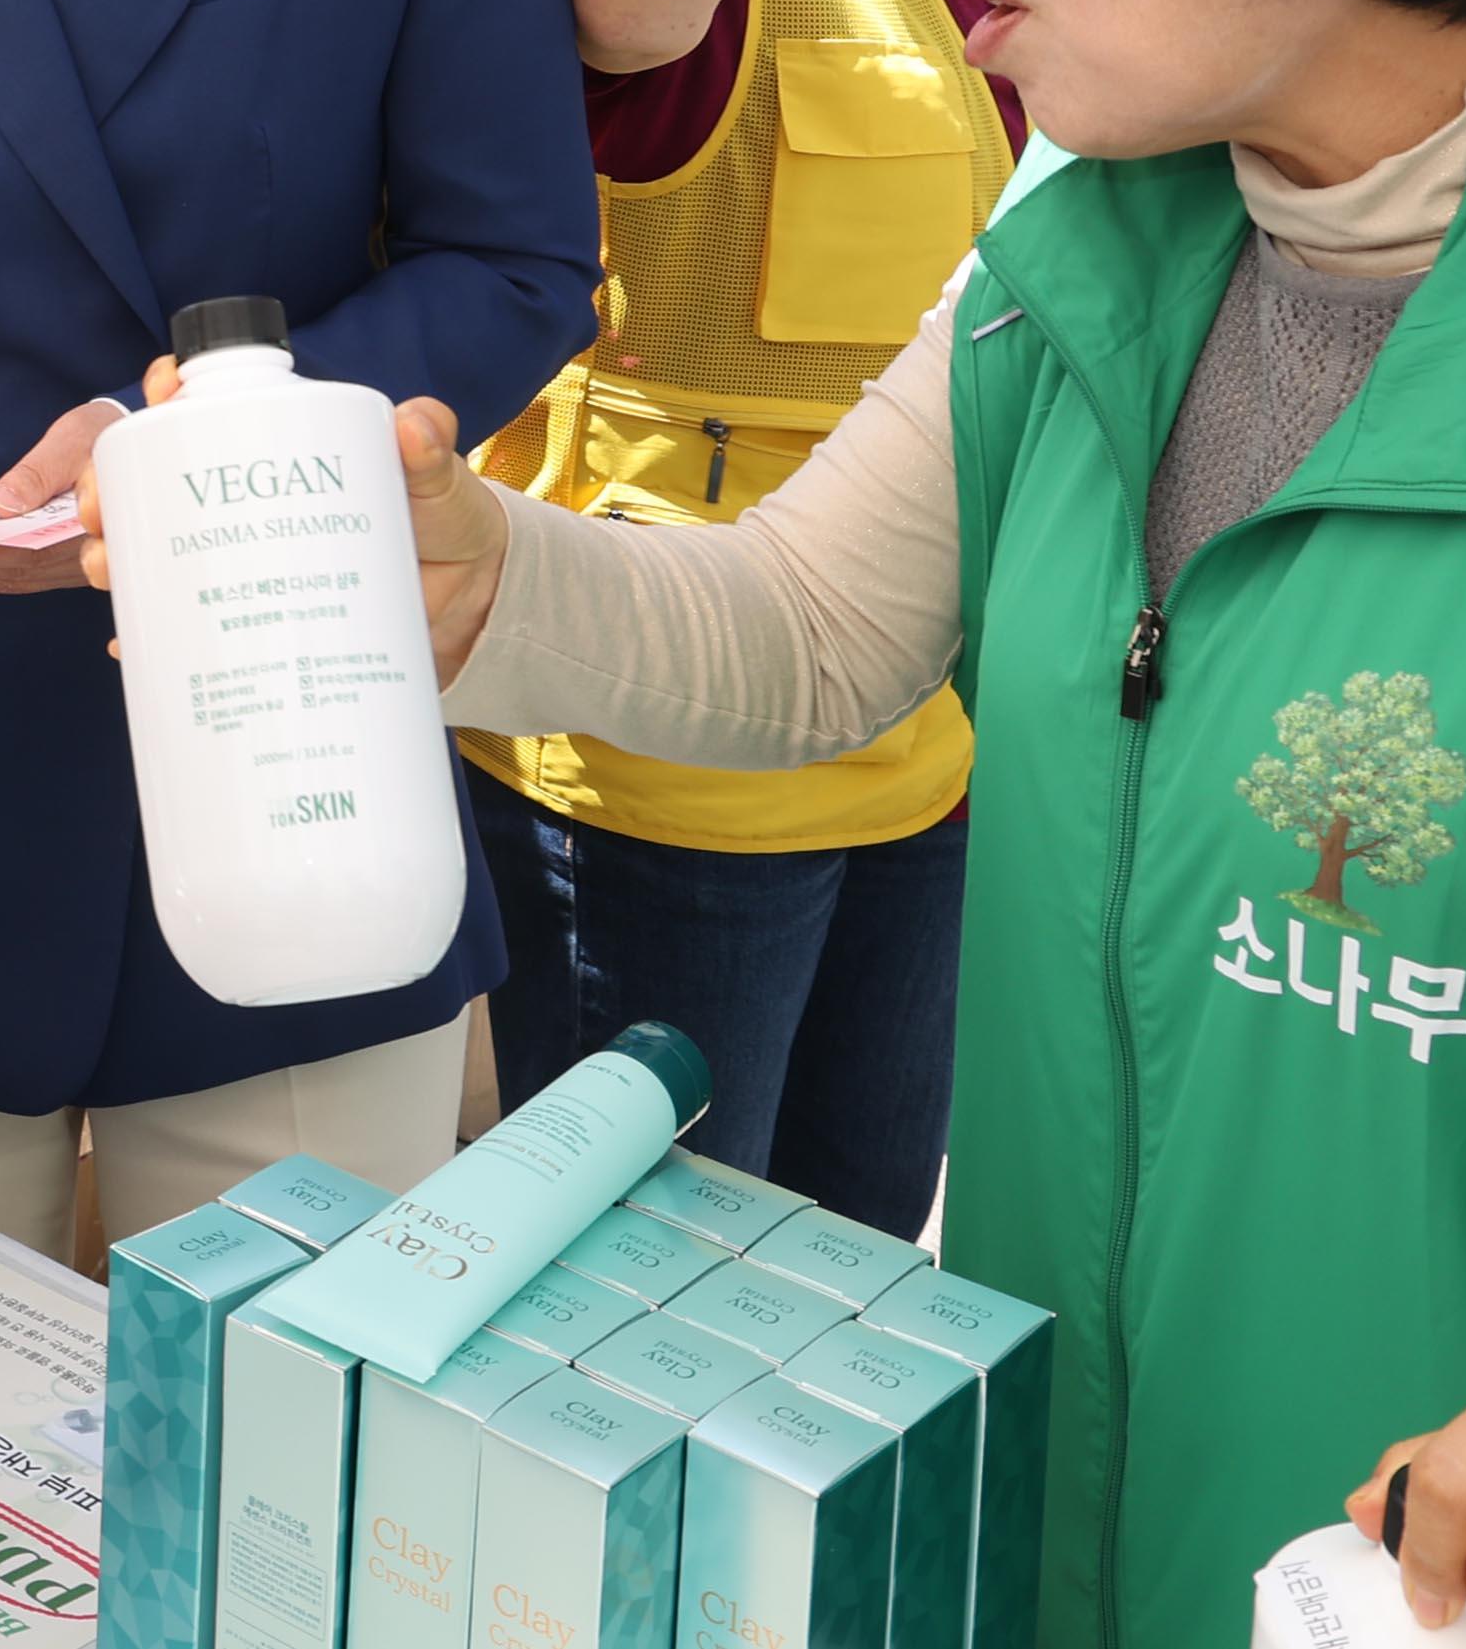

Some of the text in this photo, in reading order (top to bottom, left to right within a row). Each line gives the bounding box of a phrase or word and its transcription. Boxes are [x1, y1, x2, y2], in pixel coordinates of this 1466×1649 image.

[182, 454, 345, 507] VEGAN
[170, 513, 372, 557] DASIMA SHAMPOO
[289, 573, 333, 592] 다시마
[296, 789, 357, 824] SKIN
[281, 1185, 332, 1213] Clay
[296, 1176, 348, 1204] Crystal
[688, 1183, 742, 1214] Clay
[701, 1176, 756, 1205] Crystal
[178, 1228, 230, 1255] Clay
[389, 1200, 498, 1255] Crystal
[195, 1236, 247, 1263] Crystal
[366, 1221, 469, 1282] Clay
[606, 1239, 661, 1270] Clay
[619, 1231, 676, 1260] Crystal
[804, 1239, 860, 1269] Clay
[817, 1230, 874, 1259] Crystal
[520, 1292, 574, 1324] Clay
[725, 1294, 781, 1326] Clay
[739, 1285, 796, 1316] Crystal
[934, 1292, 994, 1321] Crystal
[921, 1302, 980, 1332] Clay
[459, 1342, 501, 1367] lay
[639, 1348, 697, 1381] Clay
[653, 1339, 713, 1371] Crystal
[855, 1348, 916, 1379] Crystal
[843, 1359, 902, 1391] Clay
[549, 1409, 610, 1443] Crystal
[565, 1399, 623, 1432] Clay
[757, 1414, 820, 1448] Crystal
[772, 1405, 832, 1438] Clay
[37, 1475, 102, 1511] 피부
[372, 1515, 453, 1583] Clay
[368, 1555, 451, 1614] Crystal
[492, 1583, 576, 1649] Clay
[699, 1590, 786, 1649] Clay
